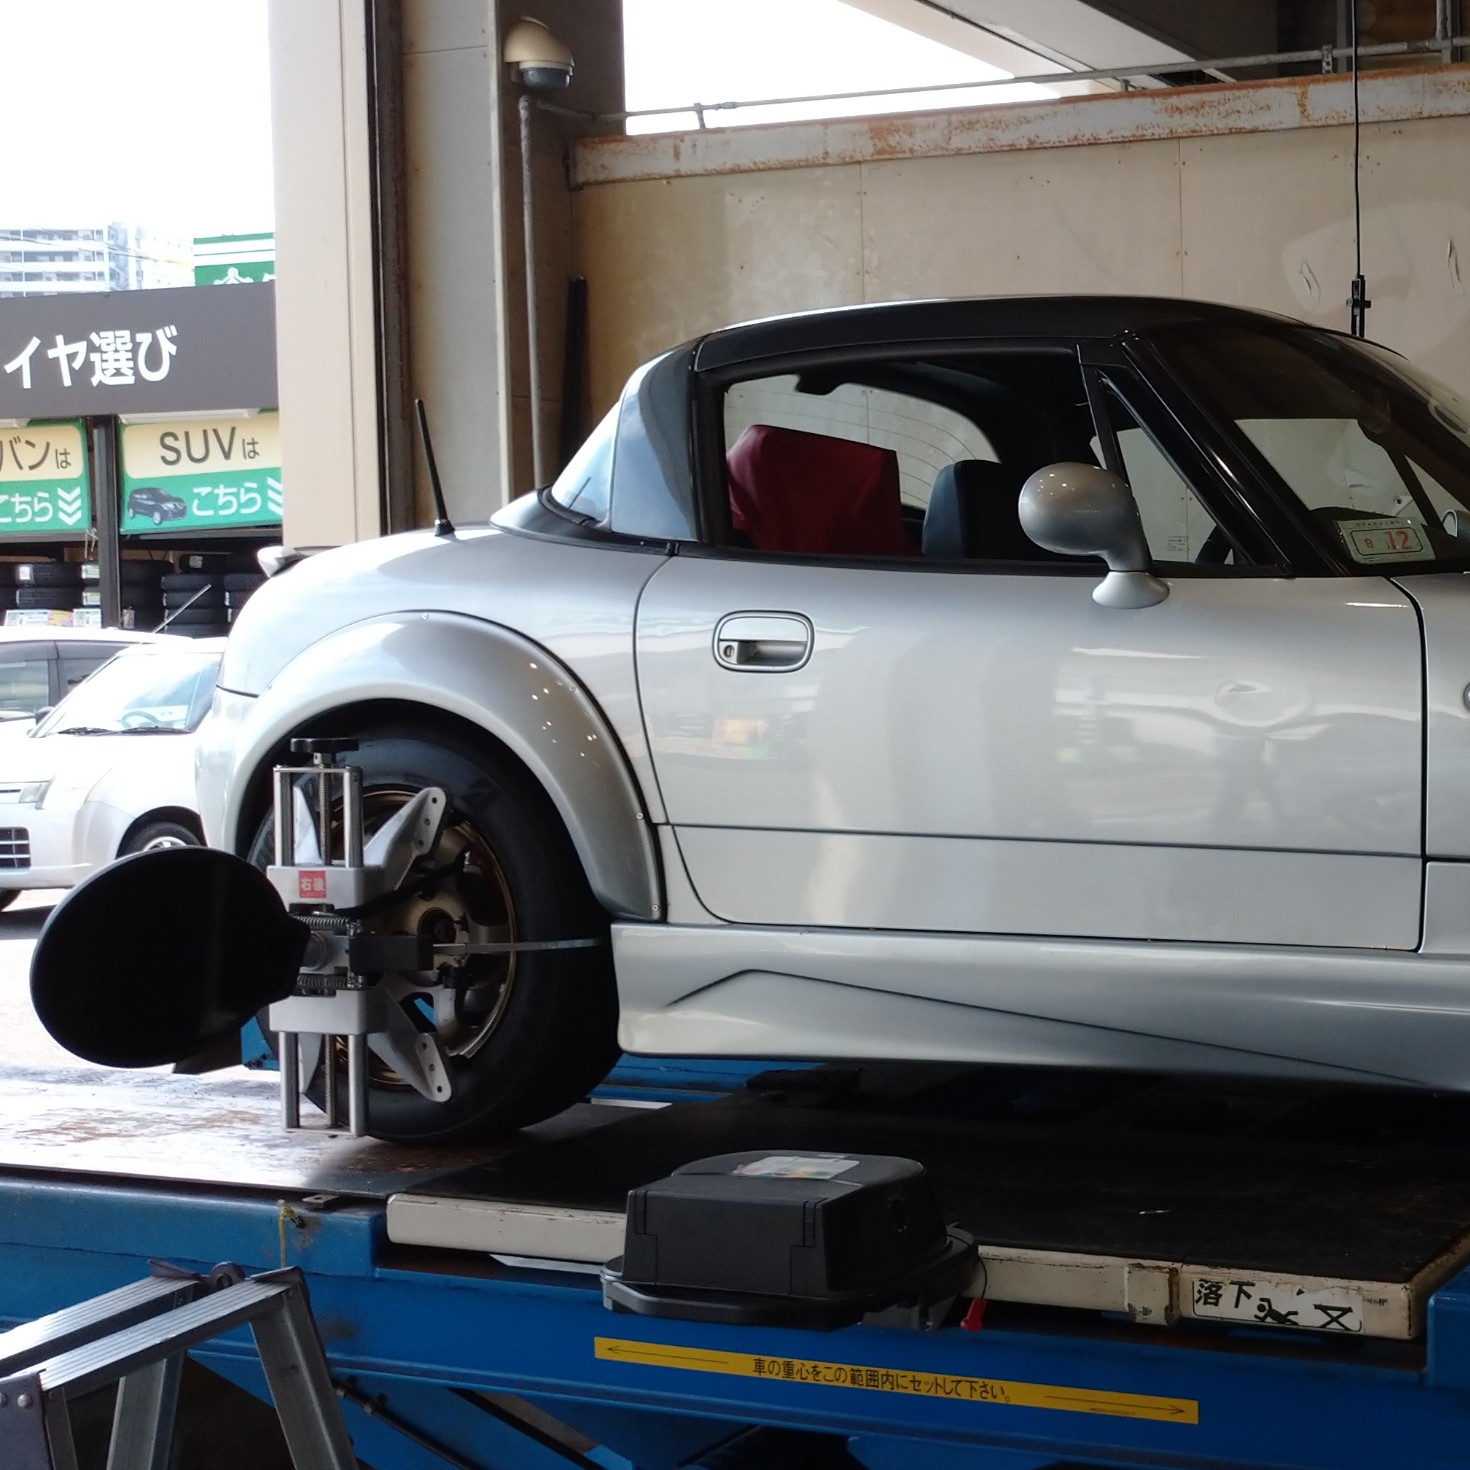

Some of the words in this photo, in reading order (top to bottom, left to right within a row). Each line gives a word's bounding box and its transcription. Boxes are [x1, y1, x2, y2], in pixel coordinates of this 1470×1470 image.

[4, 324, 179, 389] イヤ選び
[192, 482, 263, 517] こちら
[1384, 529, 1413, 550] 12
